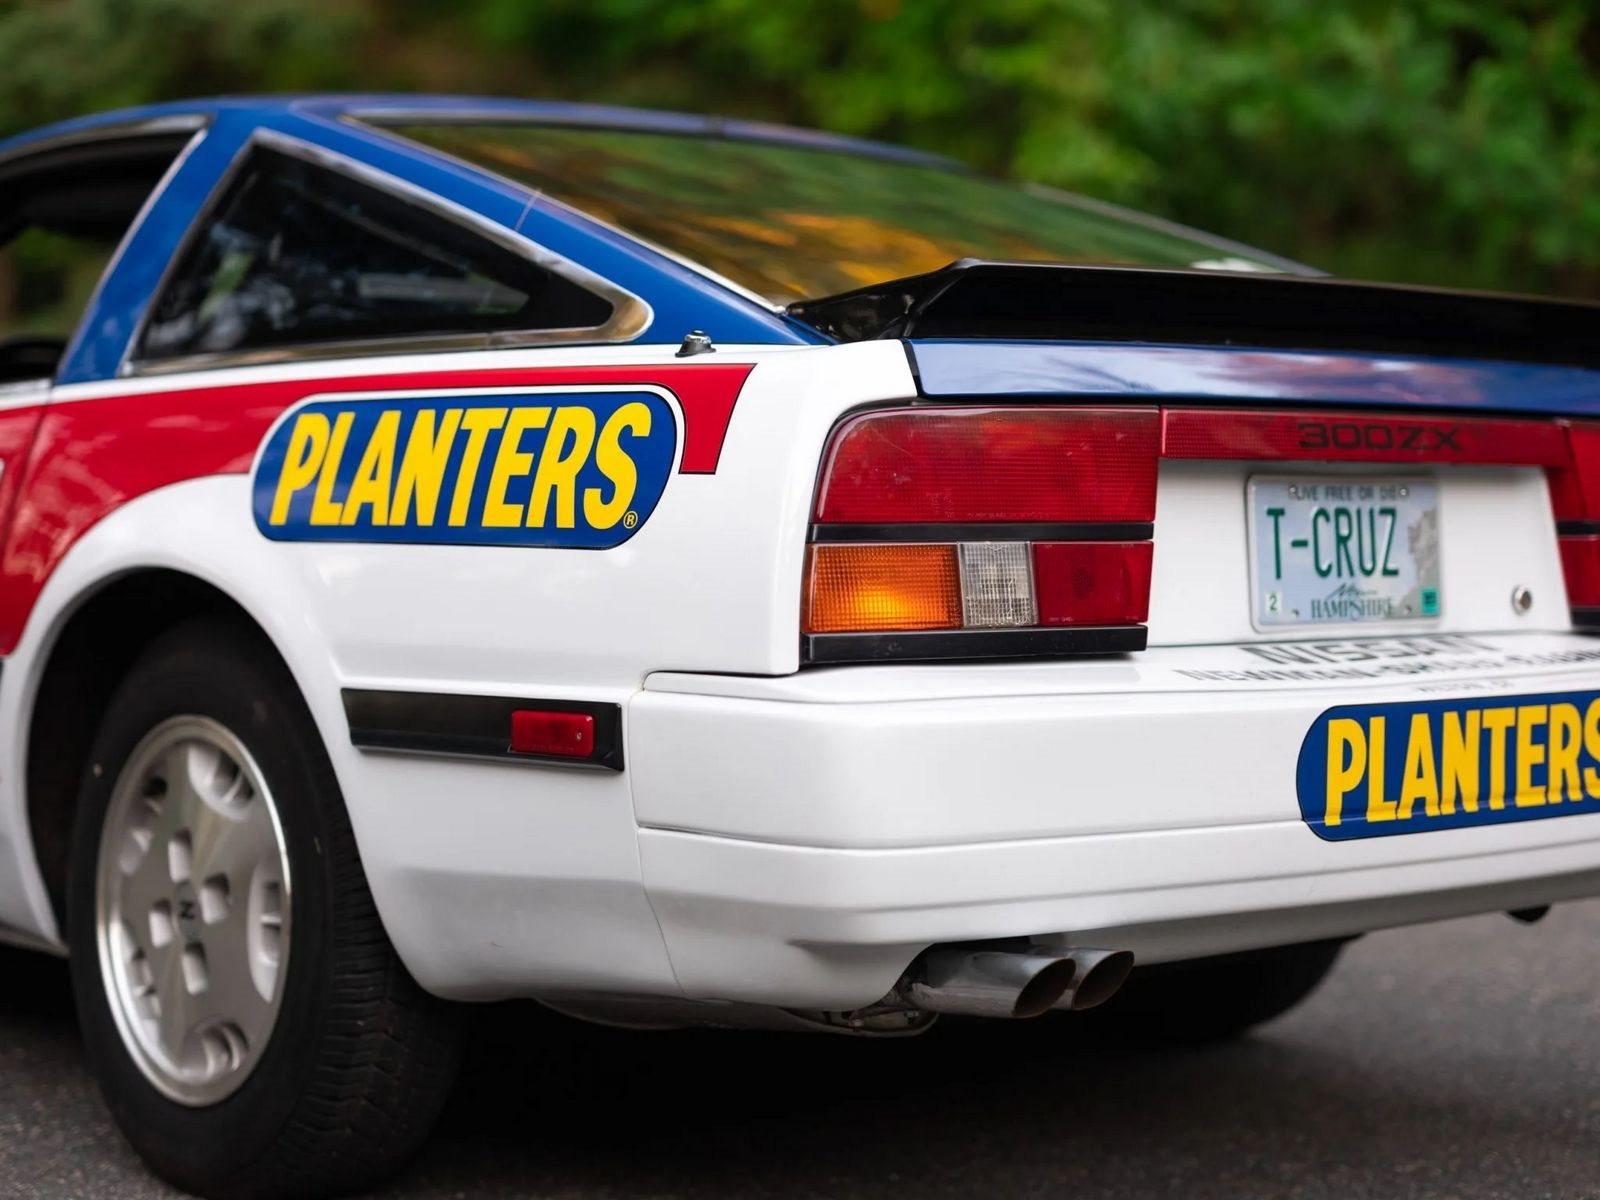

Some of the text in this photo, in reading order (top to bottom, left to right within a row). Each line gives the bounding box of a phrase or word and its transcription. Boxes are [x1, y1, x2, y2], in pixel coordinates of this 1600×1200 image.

[1298, 422, 1464, 453] 300ZX
[1325, 484, 1351, 500] FREE
[1358, 484, 1374, 500] OR
[1379, 485, 1397, 501] DIE
[1266, 507, 1400, 581] T-CRUZ
[1268, 593, 1279, 613] 2
[1310, 597, 1395, 621] HAMPSHIRE
